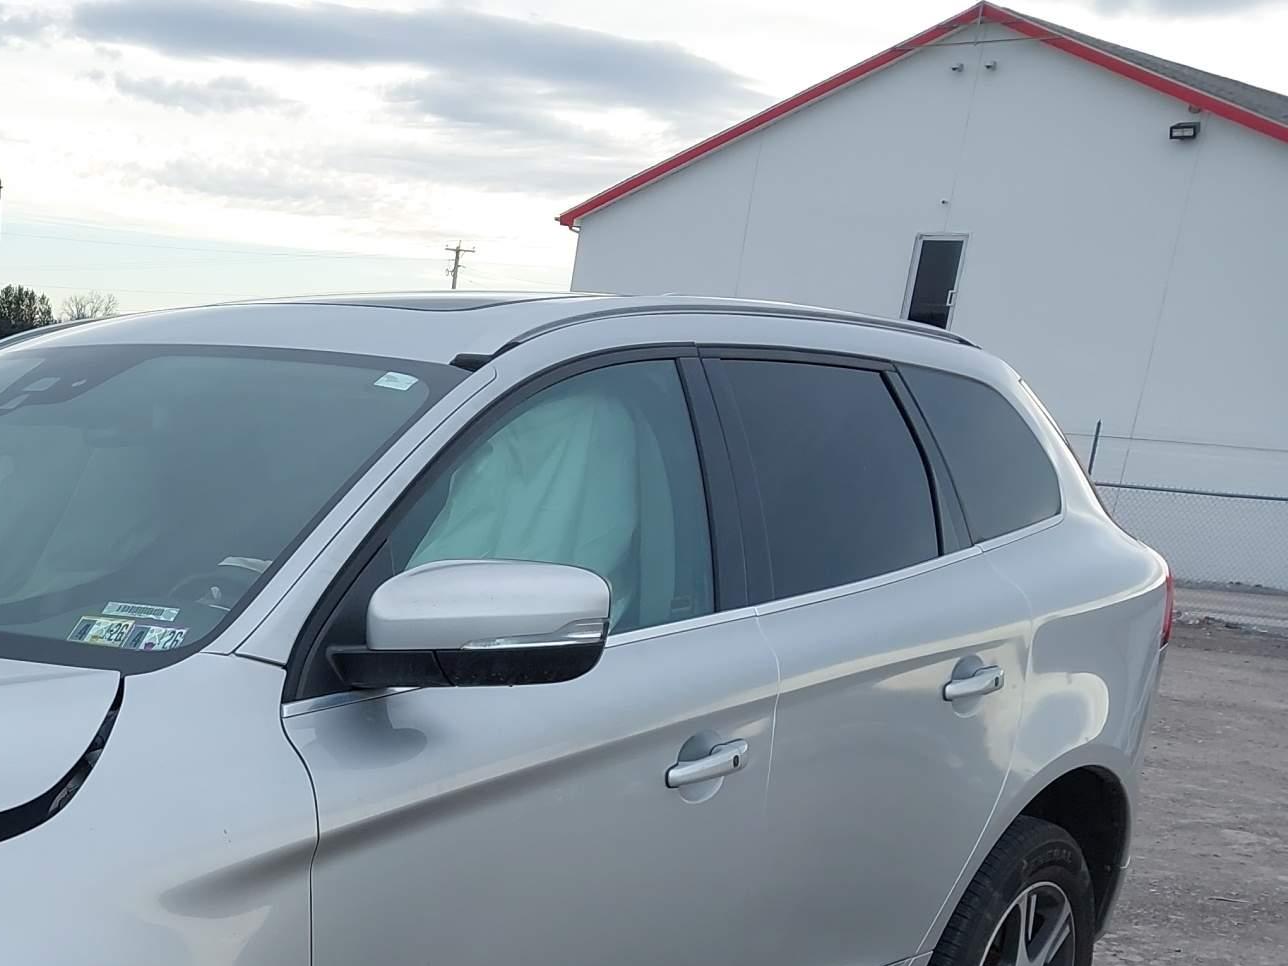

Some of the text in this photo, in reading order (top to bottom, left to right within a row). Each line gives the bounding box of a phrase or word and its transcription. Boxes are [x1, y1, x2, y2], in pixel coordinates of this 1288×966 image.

[75, 622, 130, 642] 4 26
[131, 630, 184, 650] 4 26
